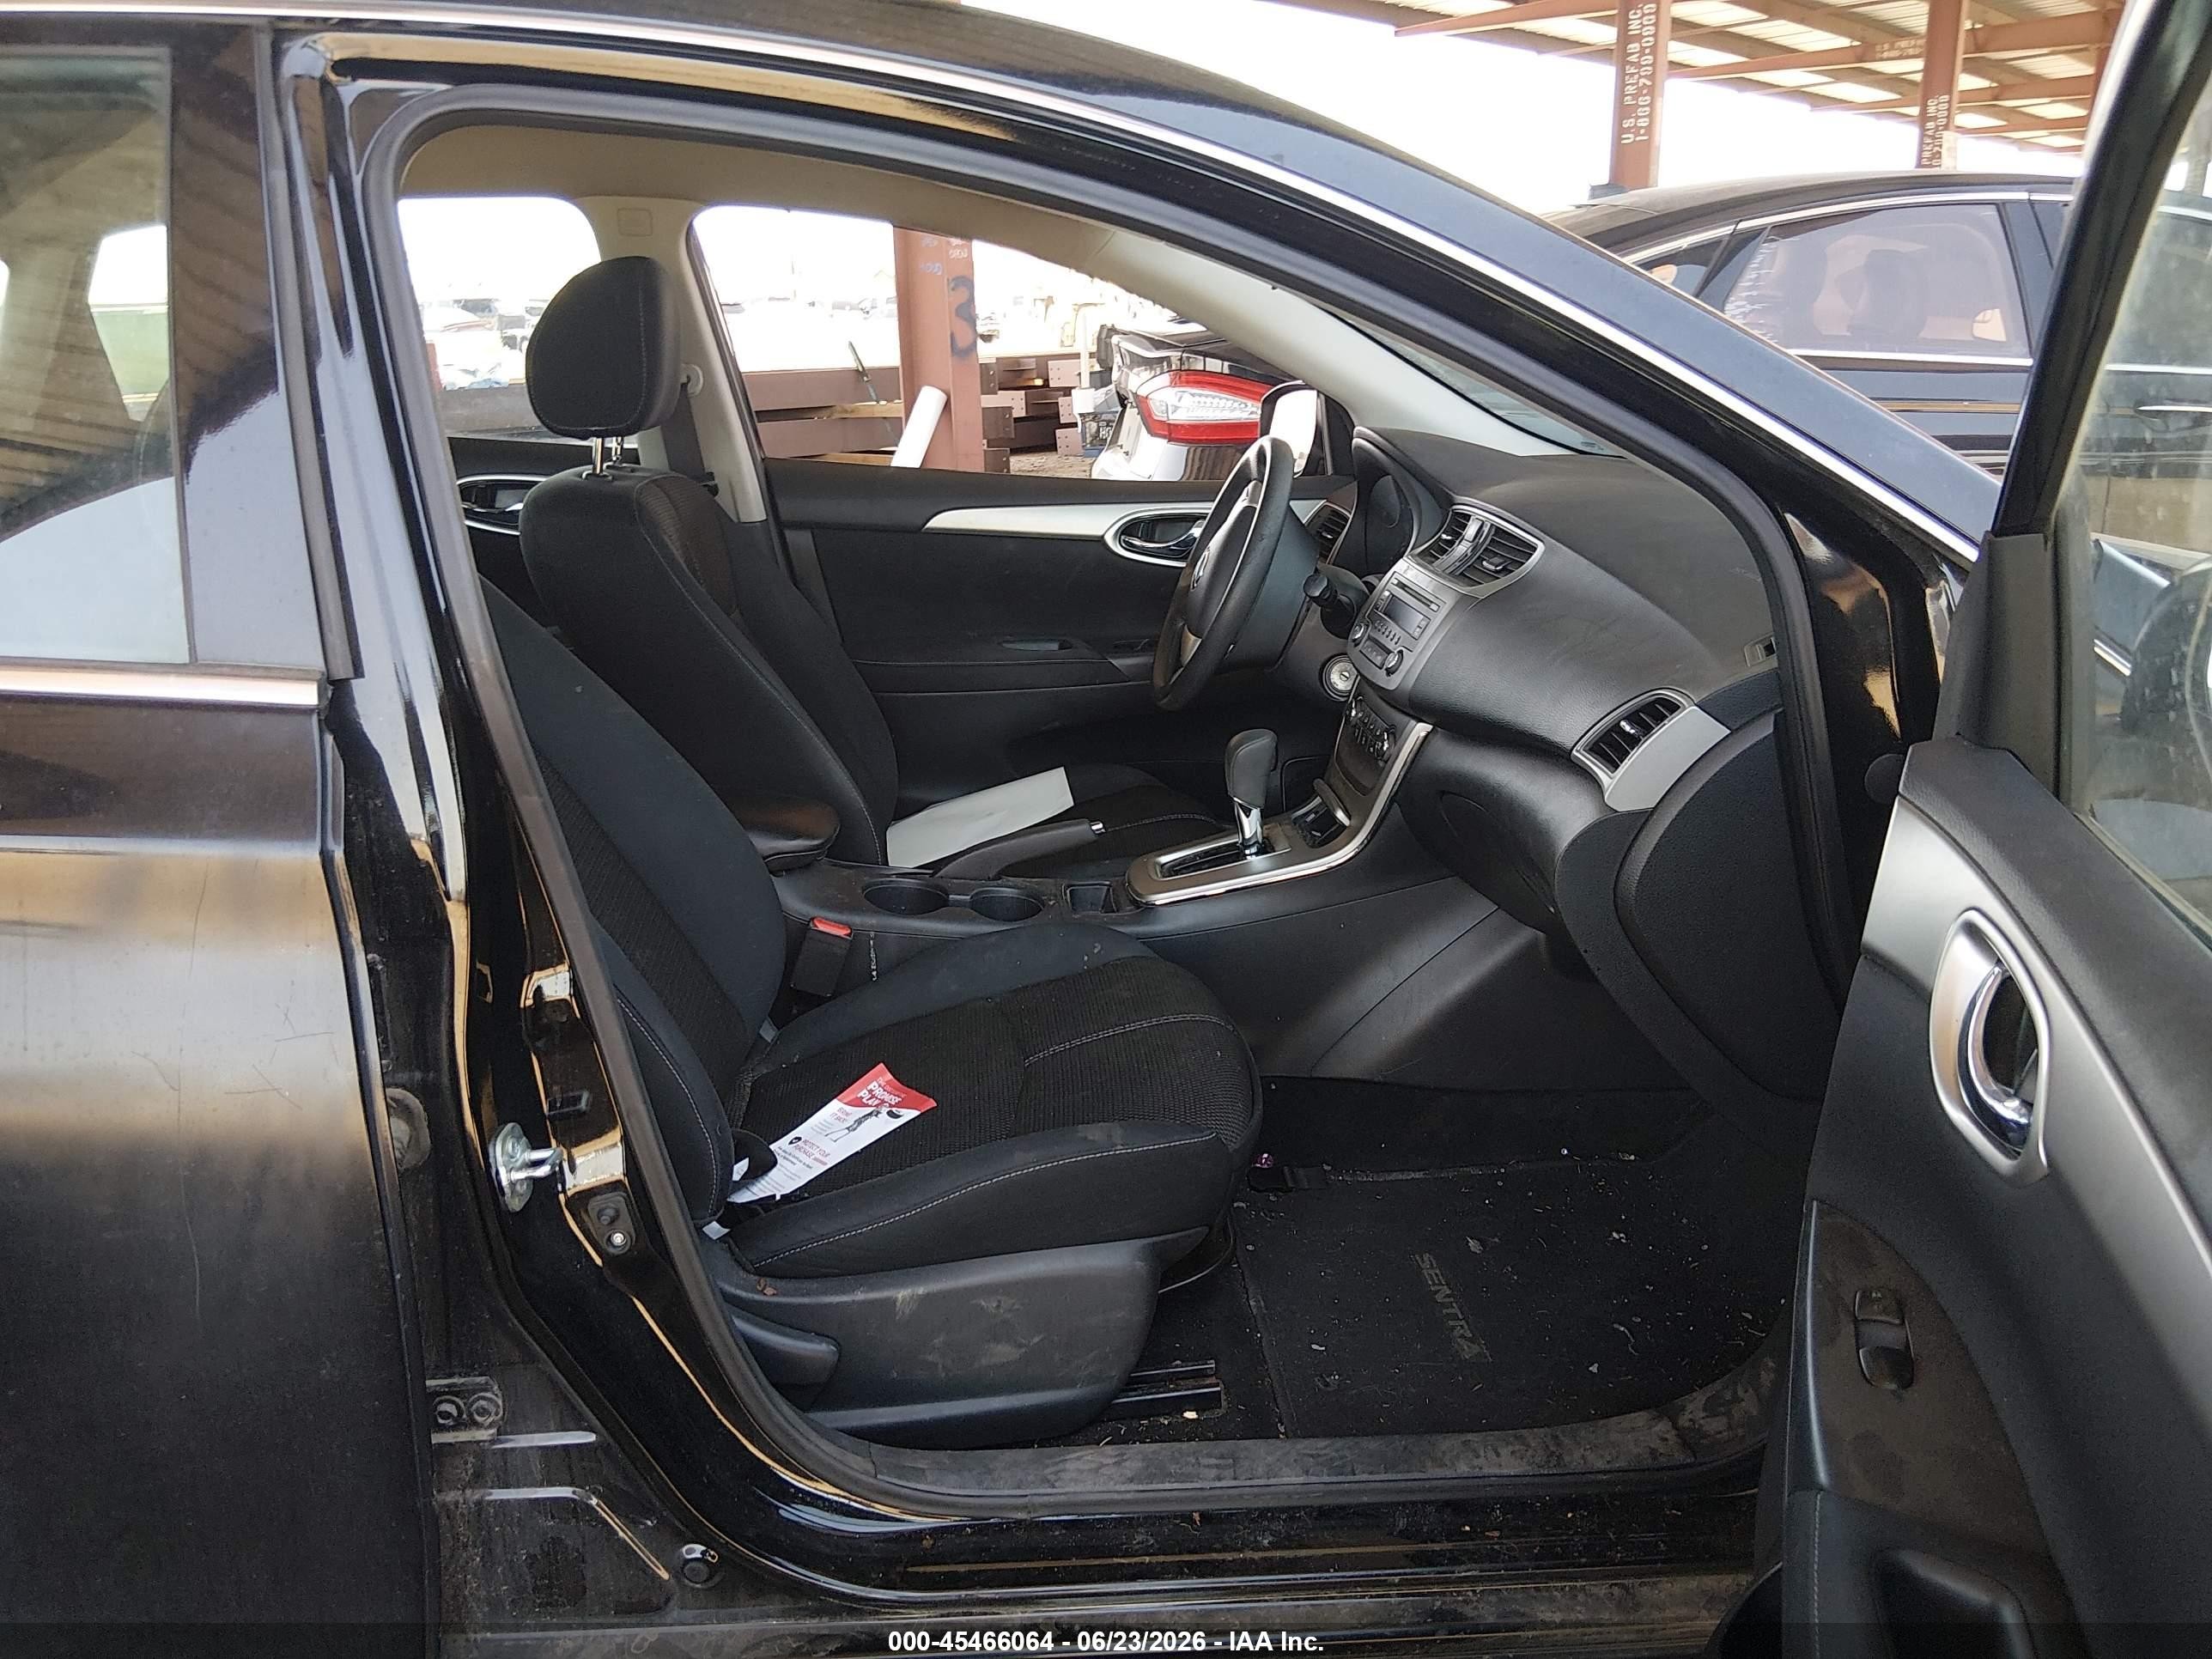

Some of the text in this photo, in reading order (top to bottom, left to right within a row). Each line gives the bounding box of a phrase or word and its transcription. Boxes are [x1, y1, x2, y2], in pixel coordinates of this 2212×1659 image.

[1621, 3, 1644, 144] U.S. PREFAB INC.
[947, 276, 978, 357] 3
[1410, 1253, 1483, 1359] SENTRA
